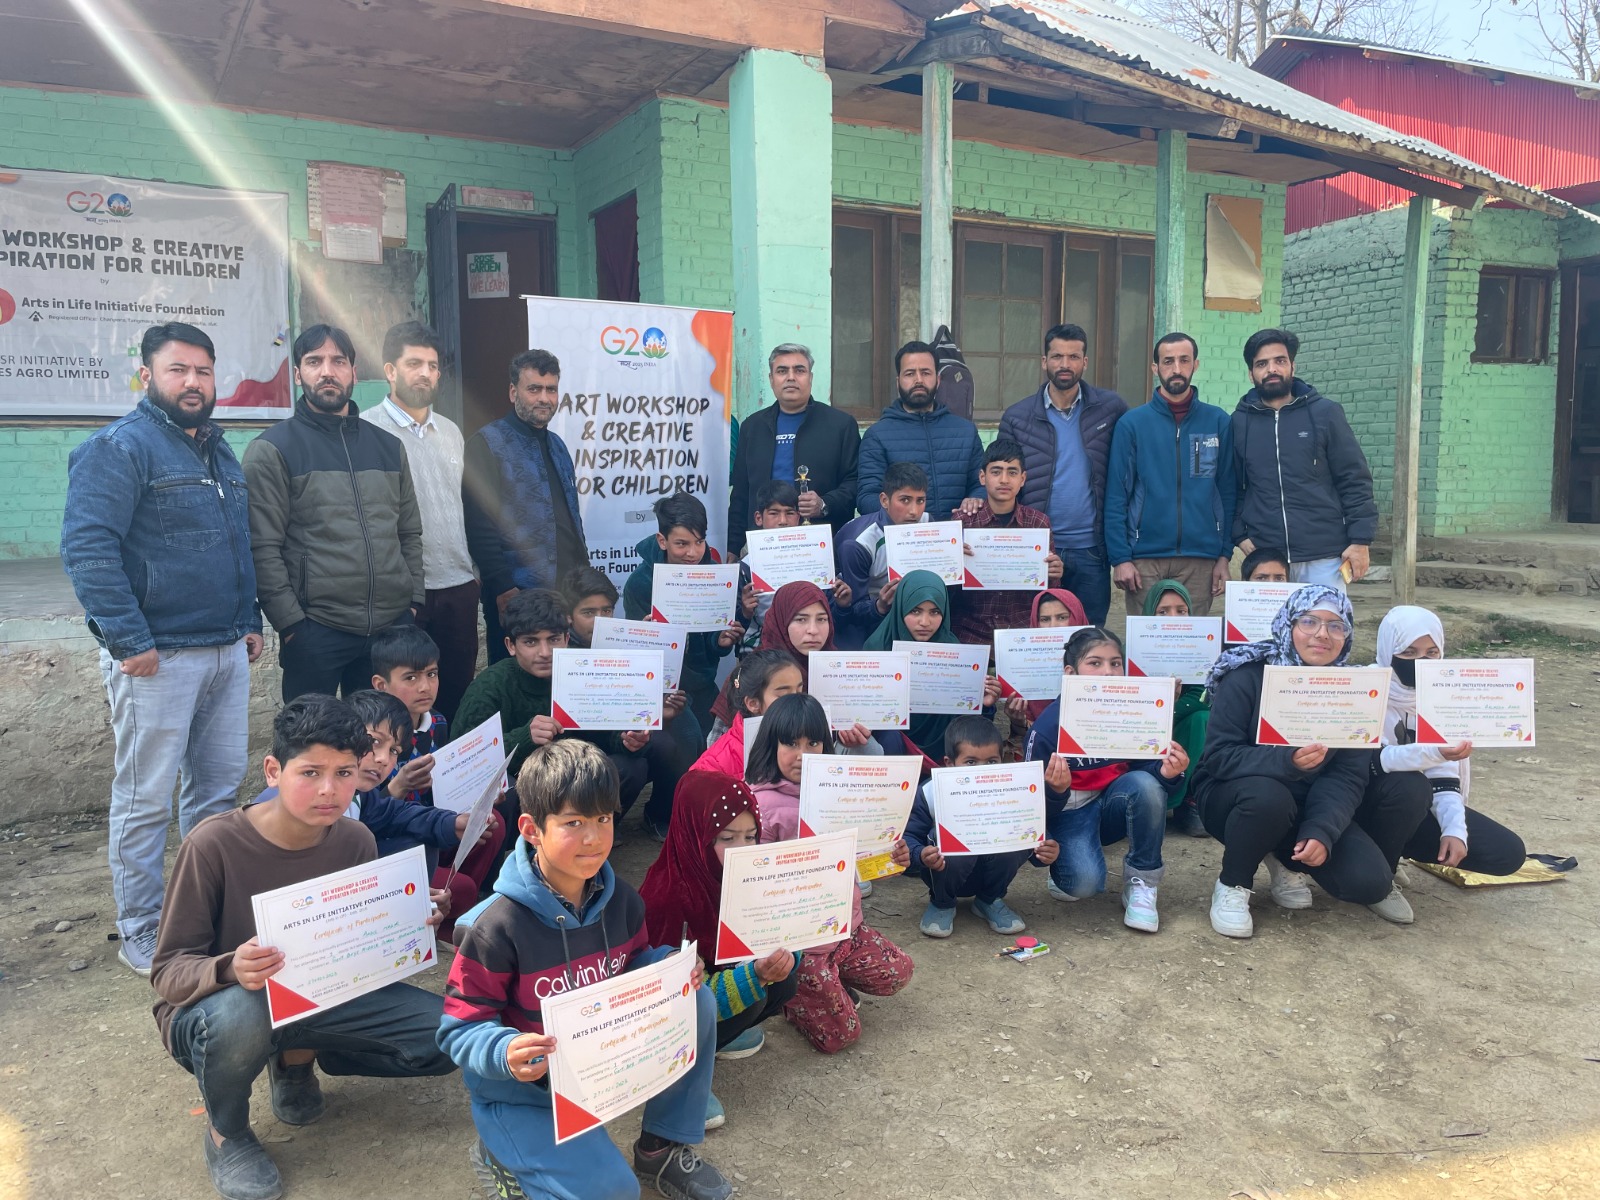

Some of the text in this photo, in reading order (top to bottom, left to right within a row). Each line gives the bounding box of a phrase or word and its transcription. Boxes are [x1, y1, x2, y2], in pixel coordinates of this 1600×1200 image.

[2, 230, 244, 260] WORKSHOP & CREATIVE
[104, 256, 143, 273] FOR
[151, 259, 240, 279] CHILDREN
[469, 262, 501, 273] GARDEN
[470, 280, 508, 293] WE LEARN
[22, 297, 225, 316] Arts in Life Initiative Foundation
[20, 356, 84, 366] INITIATIVE
[90, 358, 103, 366] BY
[16, 368, 53, 378] AGRO
[58, 369, 109, 379] LIMITED
[558, 392, 709, 418] ART WORKSHOP
[581, 420, 693, 444] & CREATIVE
[575, 449, 698, 471] INSPIRATION
[576, 474, 709, 499] OR CHILDREN
[635, 511, 646, 522] by
[589, 546, 637, 559] rts in Lif
[777, 870, 805, 878] INITIATIVE
[806, 865, 836, 874] FOUNDATION
[331, 883, 355, 894] WORKSHOP
[284, 920, 301, 929] ARTS
[312, 913, 326, 921] LIFE
[328, 902, 363, 916] INITIATIVE
[364, 889, 403, 906] FOUNDATION
[535, 964, 598, 999] Calvin
[618, 987, 640, 999] WORKSHOP
[572, 1029, 589, 1039] ARTS
[600, 1020, 613, 1030] LIFE
[614, 1007, 647, 1024] INITIATIVE
[648, 991, 681, 1010] FOUNDATION
